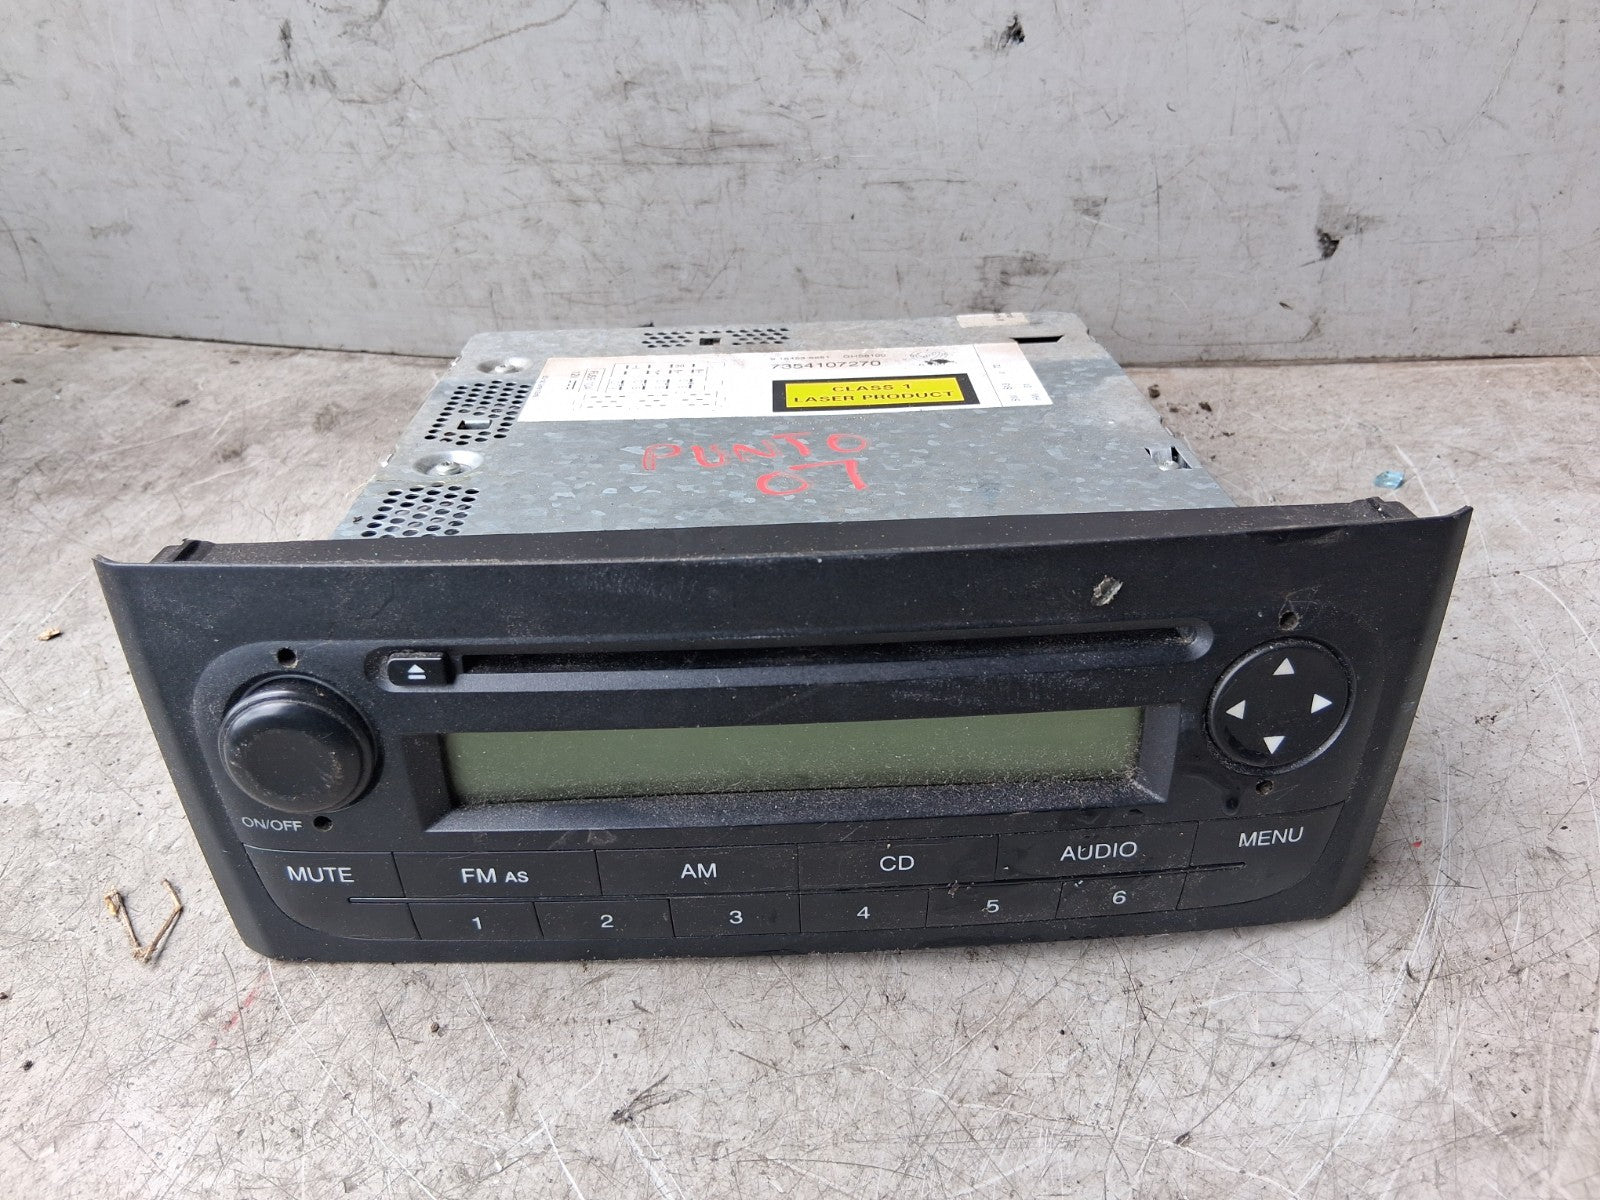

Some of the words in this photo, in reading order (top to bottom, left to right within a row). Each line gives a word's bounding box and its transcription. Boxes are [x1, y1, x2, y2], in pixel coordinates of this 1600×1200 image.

[771, 359, 882, 370] 7354107270
[832, 383, 894, 392] CLASS
[794, 395, 855, 403] LASER
[862, 390, 954, 401] PRODUCT
[642, 431, 869, 471] PUNTO
[241, 816, 303, 832] ON/OFF
[1238, 826, 1305, 848] MENU
[1060, 841, 1138, 862] AUDIO
[680, 862, 718, 879] AM
[879, 855, 915, 872] CD
[287, 866, 355, 884] MUTE
[461, 868, 498, 884] FM
[505, 871, 530, 883] AS
[1112, 890, 1127, 905] 6
[856, 906, 871, 919] 4
[986, 899, 1000, 913] 5
[471, 916, 483, 930] 1
[600, 914, 614, 928] 2
[729, 910, 744, 925] 3
